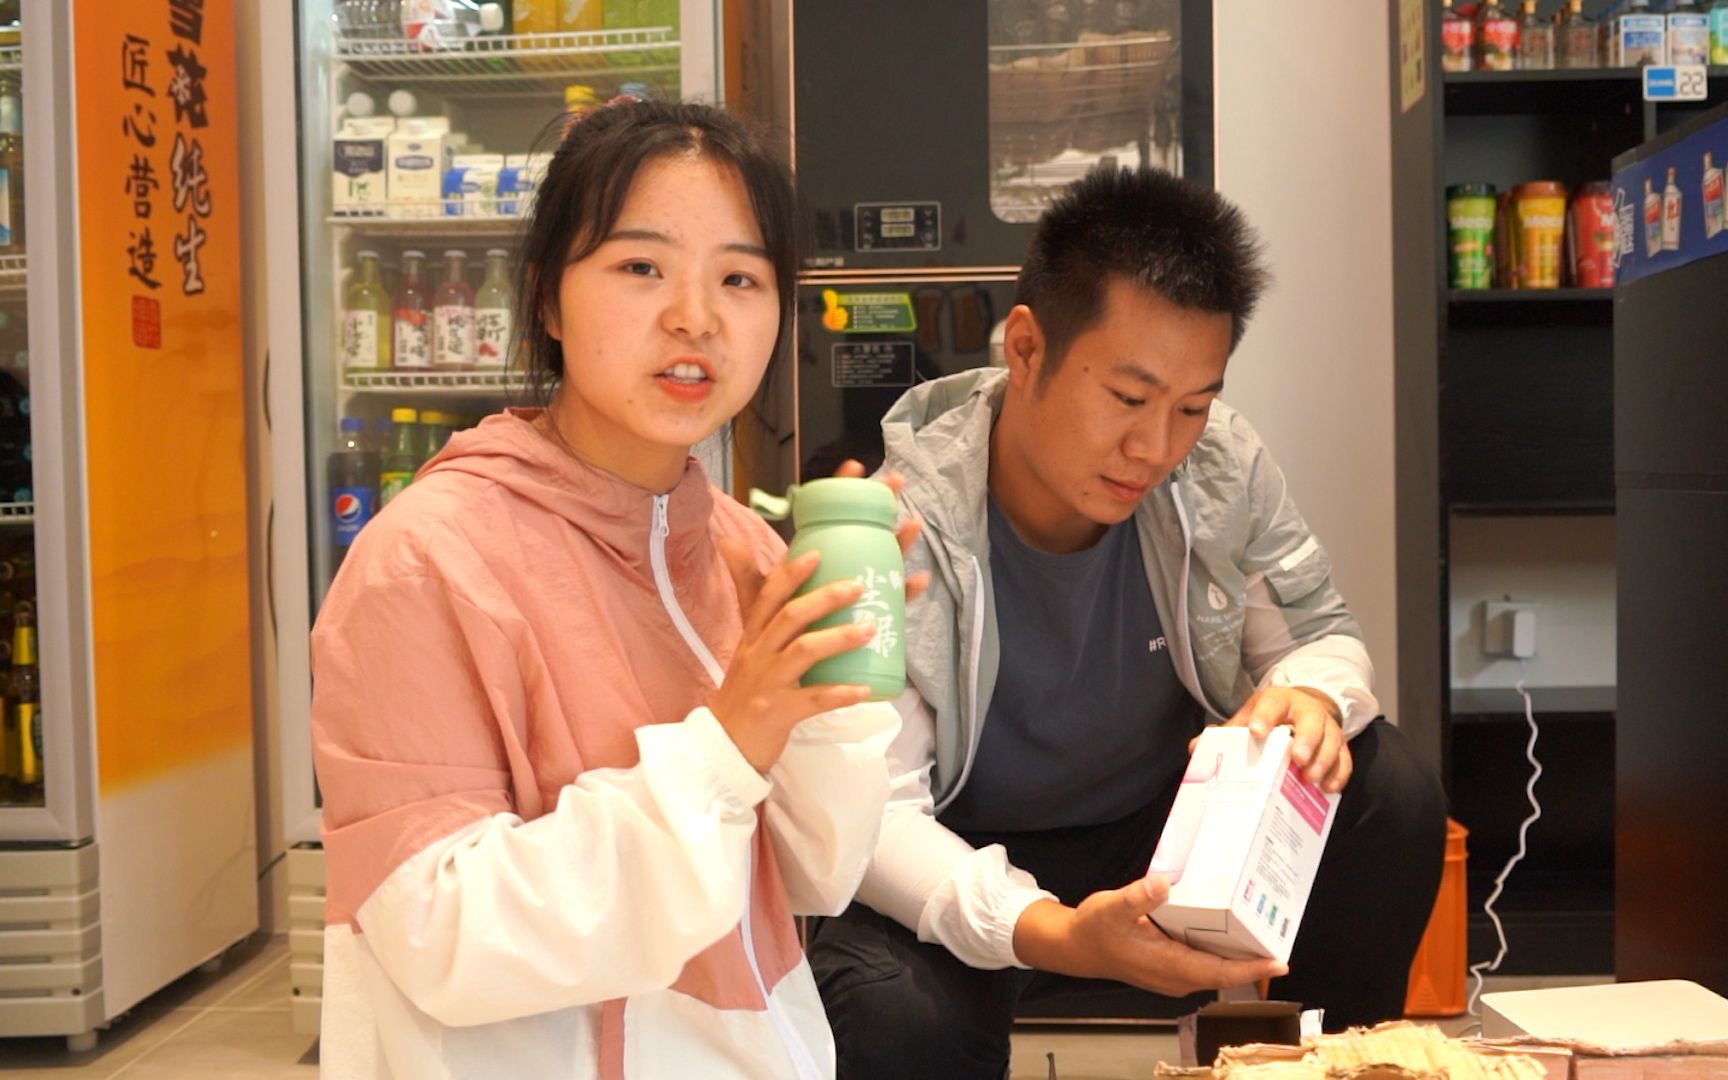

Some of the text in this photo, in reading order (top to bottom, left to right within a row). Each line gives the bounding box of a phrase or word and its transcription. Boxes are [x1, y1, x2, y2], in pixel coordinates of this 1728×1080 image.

[1680, 71, 1704, 96] 22
[122, 33, 163, 290] 匠心营造
